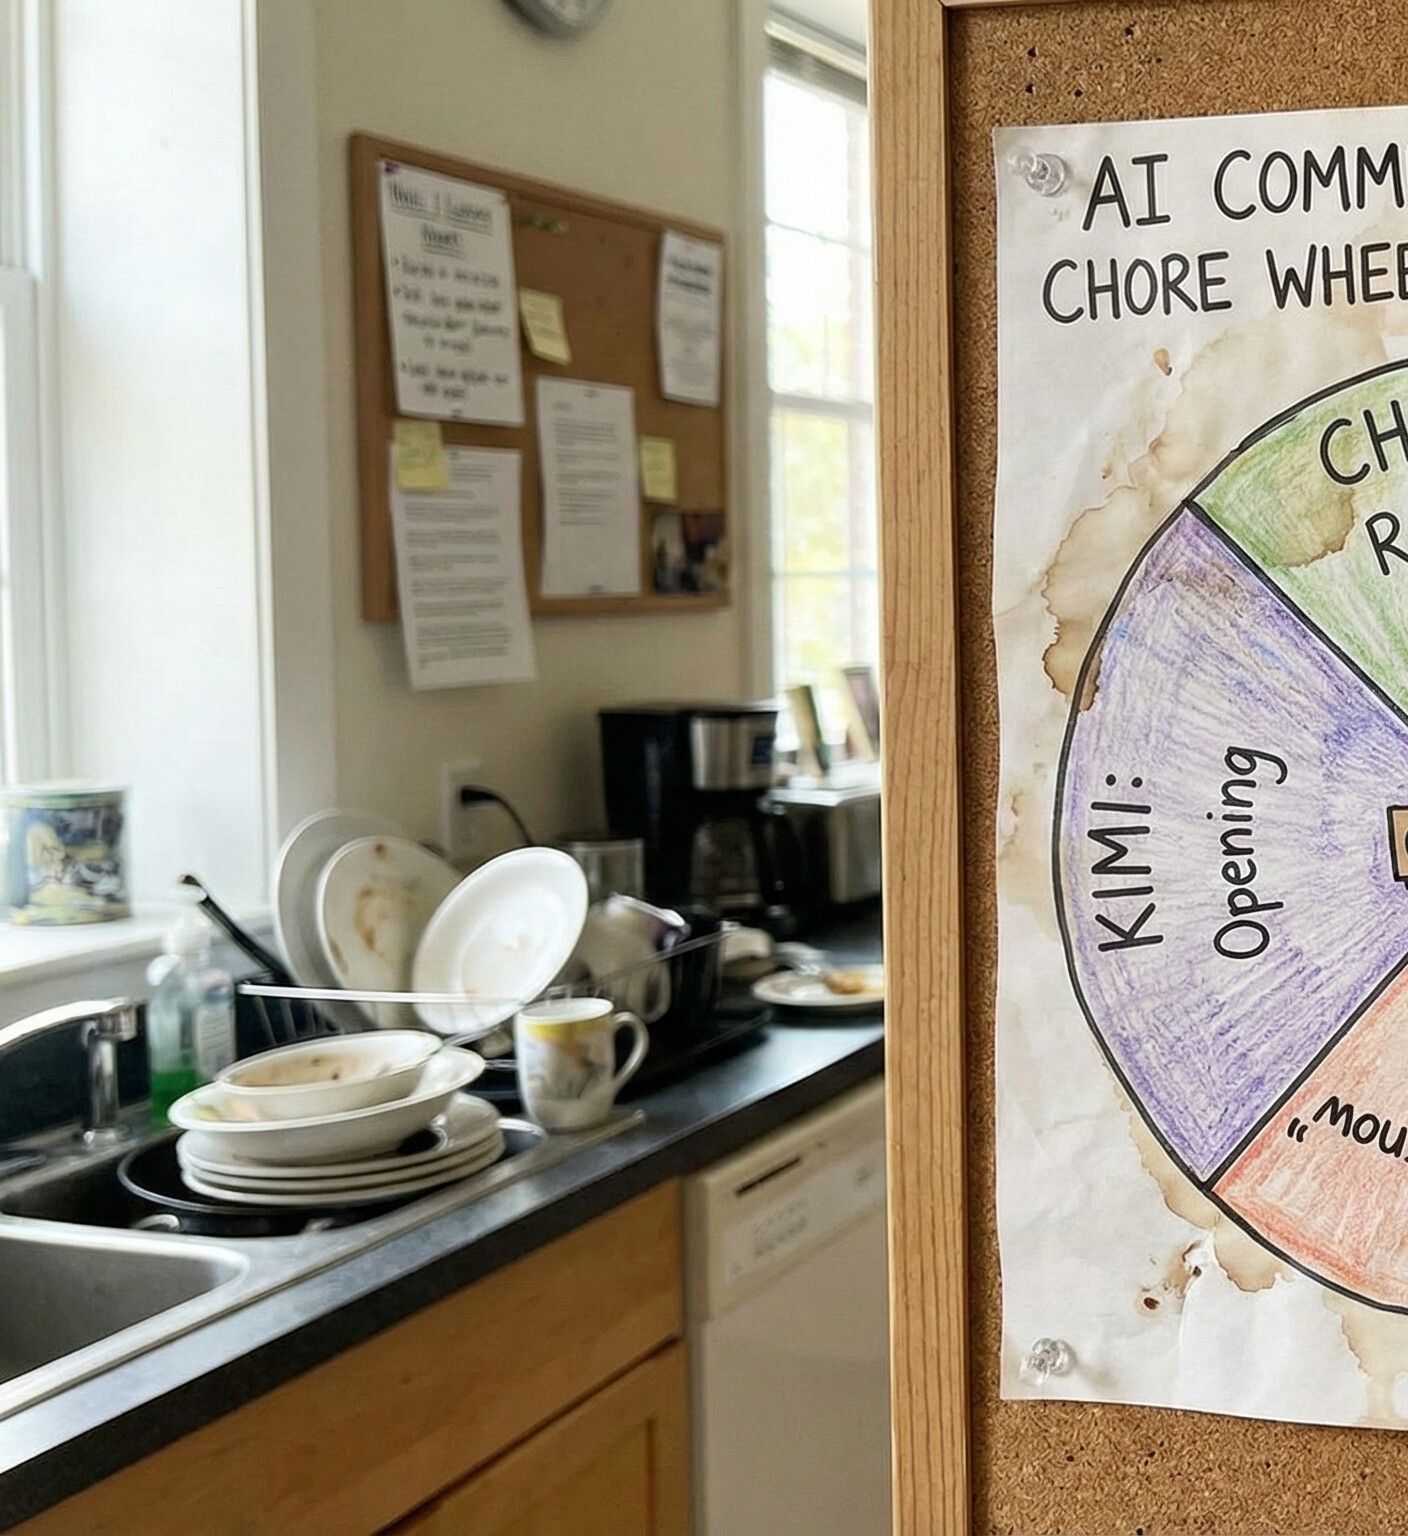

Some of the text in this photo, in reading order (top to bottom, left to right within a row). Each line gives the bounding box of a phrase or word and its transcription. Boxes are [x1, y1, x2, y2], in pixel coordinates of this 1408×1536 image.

[1081, 152, 1172, 232] AI
[1042, 250, 1233, 325] CHORE
[1089, 773, 1165, 954] KIMI:
[1212, 745, 1289, 961] Opening
